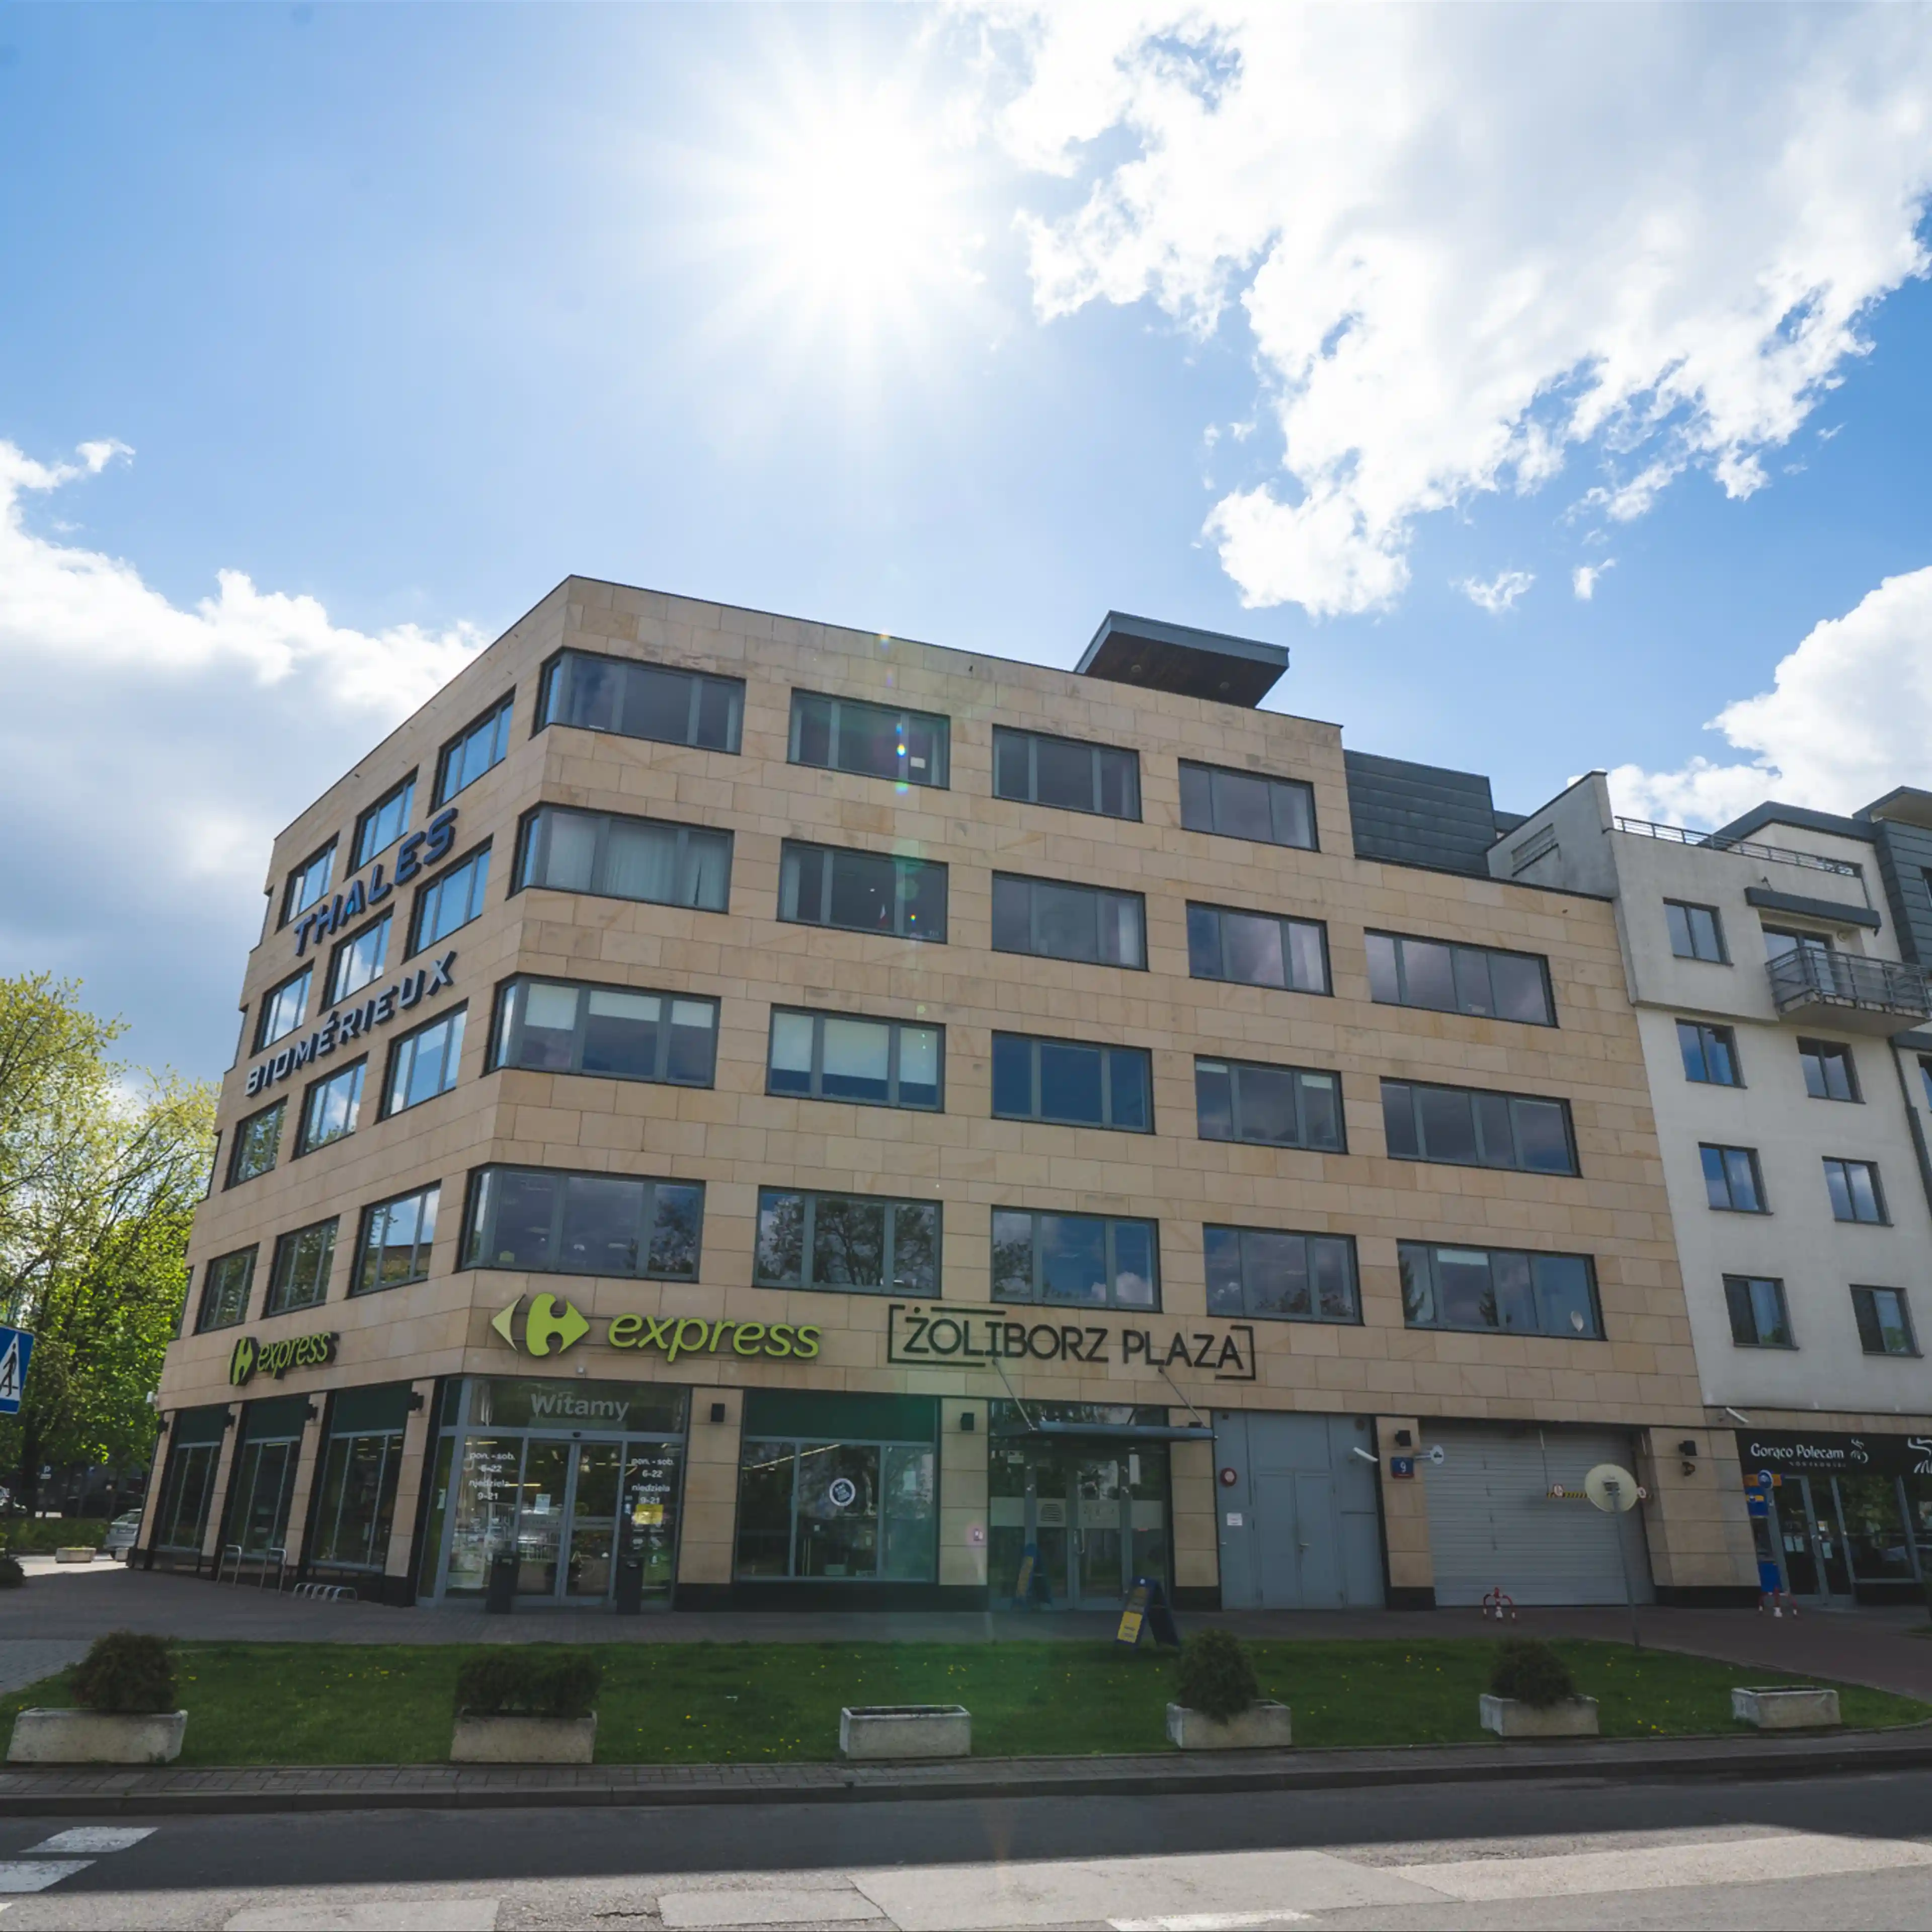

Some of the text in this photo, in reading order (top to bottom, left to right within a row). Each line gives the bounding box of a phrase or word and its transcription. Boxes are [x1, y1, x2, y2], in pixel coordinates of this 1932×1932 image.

[293, 807, 459, 957] THALES
[244, 950, 458, 1099] BIOMÉRIEUX
[257, 1331, 339, 1380] express
[608, 1313, 822, 1362] express
[903, 1306, 1244, 1371] ŻOLIBORZ PLAZA
[531, 1393, 629, 1421] Witamy
[642, 1469, 663, 1478] 6-22
[1400, 1461, 1407, 1473] 9
[1796, 1443, 1845, 1459] Polecam
